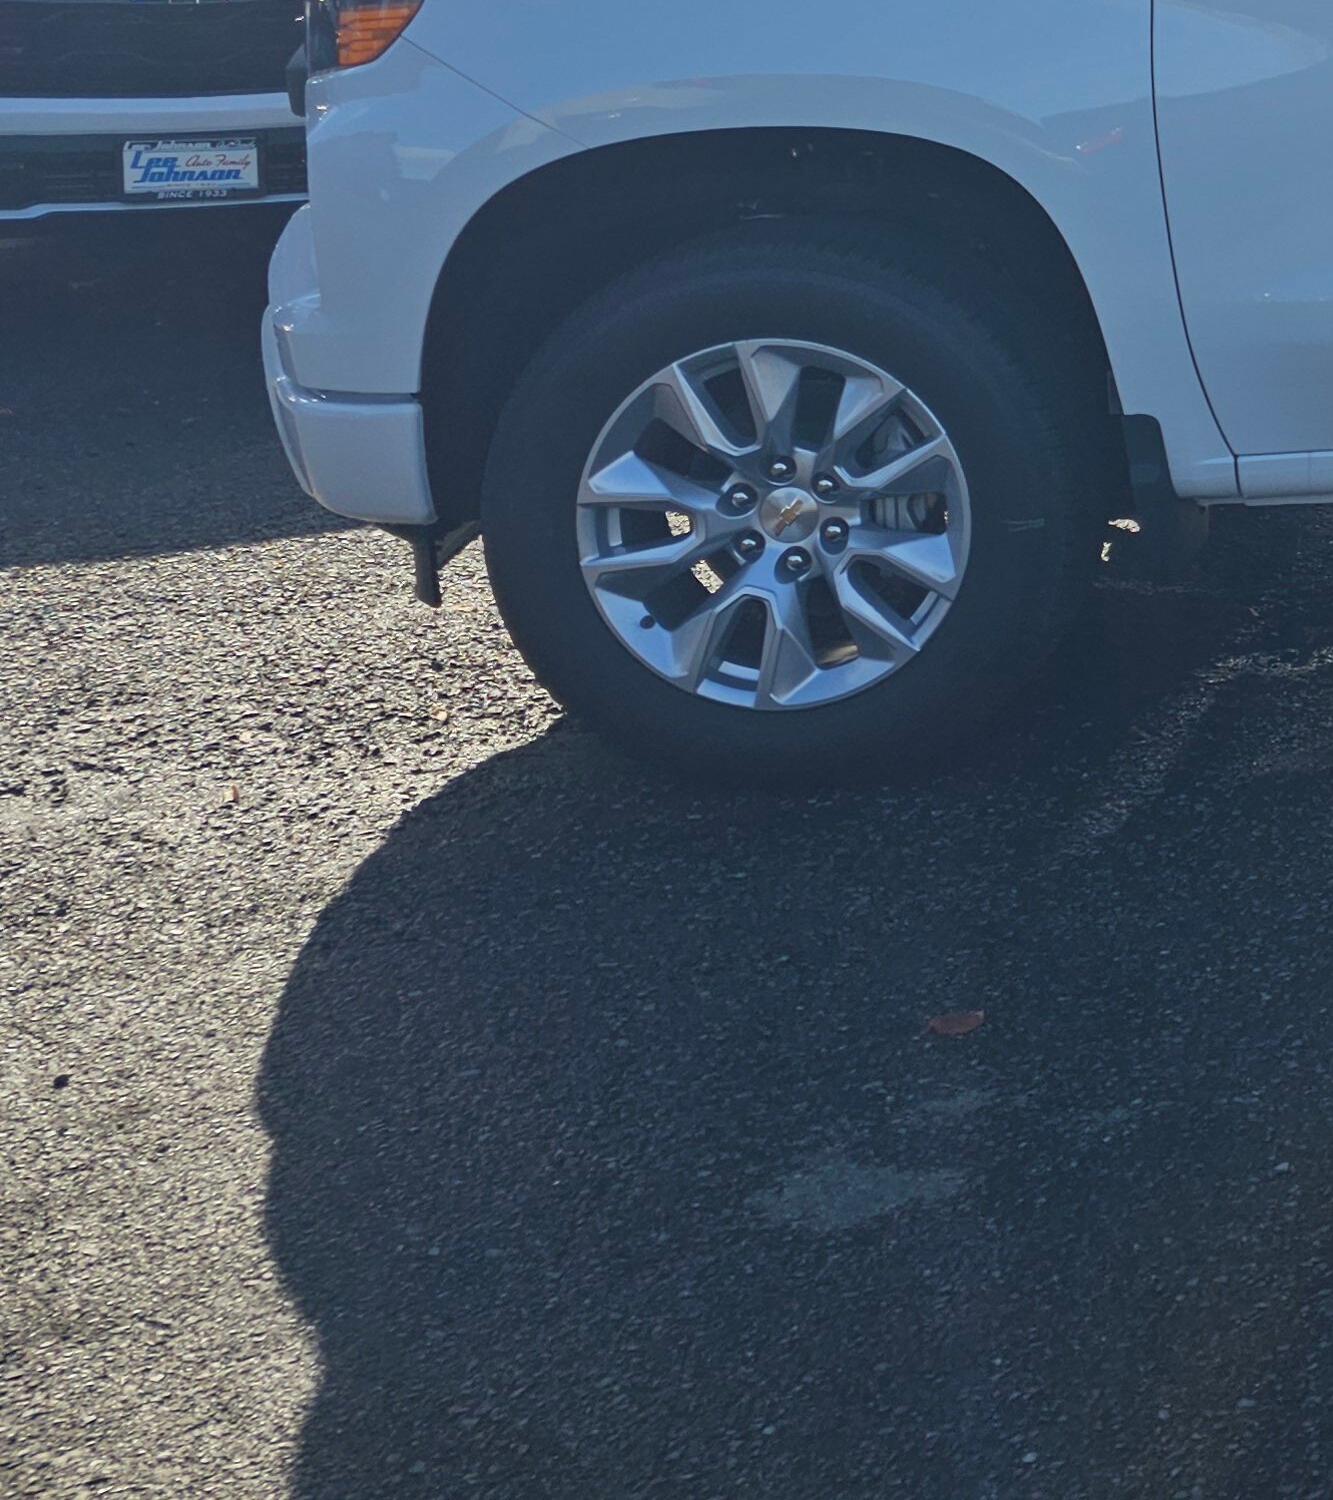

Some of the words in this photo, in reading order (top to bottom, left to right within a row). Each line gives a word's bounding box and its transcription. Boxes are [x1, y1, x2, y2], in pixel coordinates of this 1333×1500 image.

[130, 151, 181, 169] Lee
[185, 155, 214, 168] Auto
[215, 154, 251, 169] Family
[133, 164, 244, 183] Johnson
[157, 190, 193, 199] SINCE
[199, 189, 227, 198] 1933
